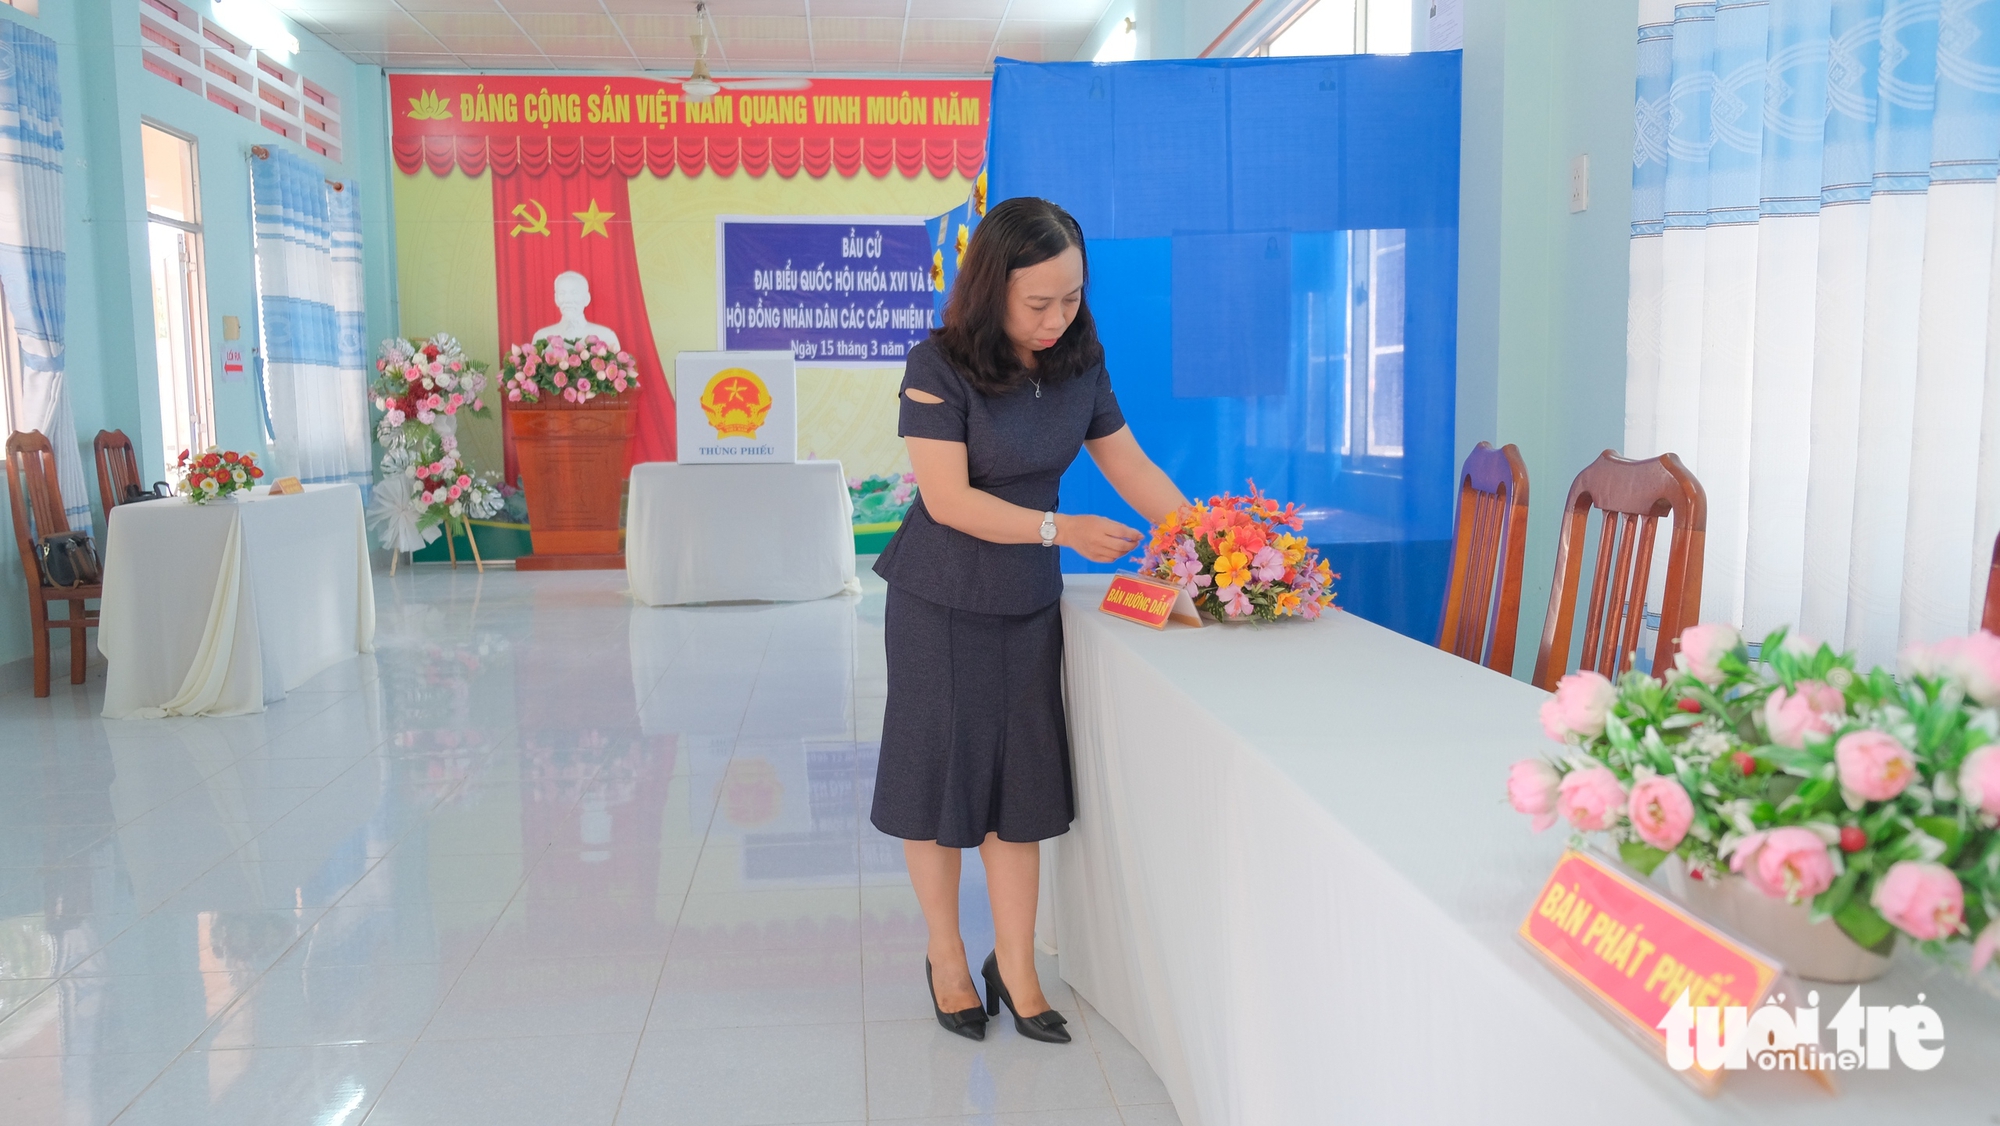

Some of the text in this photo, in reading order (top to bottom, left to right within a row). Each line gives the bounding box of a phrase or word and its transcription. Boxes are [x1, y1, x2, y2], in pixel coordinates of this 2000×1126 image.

[461, 83, 980, 130] ĐẢNG CỘNG SẢN VIỆT NAM QUANG VINH MUÔN NĂM
[842, 227, 882, 259] BẦU CỬ
[754, 269, 773, 296] ĐẠI
[775, 258, 798, 291] BIỂU
[801, 262, 833, 292] QUỐC
[835, 263, 854, 298] HỘI
[857, 265, 887, 292] KHÓA
[889, 271, 907, 292] XVI
[910, 265, 925, 292] VÀ
[726, 302, 745, 334] HỘI
[748, 297, 780, 329] ĐỒNG
[783, 302, 812, 329] NHÂN
[815, 302, 838, 329] DÂN
[840, 303, 864, 329] CÁC
[867, 301, 889, 329] CẤP
[891, 304, 924, 335] NHIỆM
[791, 339, 817, 359] Ngày
[820, 340, 834, 356] 15
[837, 340, 868, 359] tháng
[870, 340, 878, 356] 3
[881, 341, 904, 356] năm
[699, 444, 775, 455] THÙNG PHIẾU
[1123, 591, 1151, 612] HƯỚNG
[1538, 880, 1592, 943] BÀN
[1586, 911, 1656, 979] PHÁT
